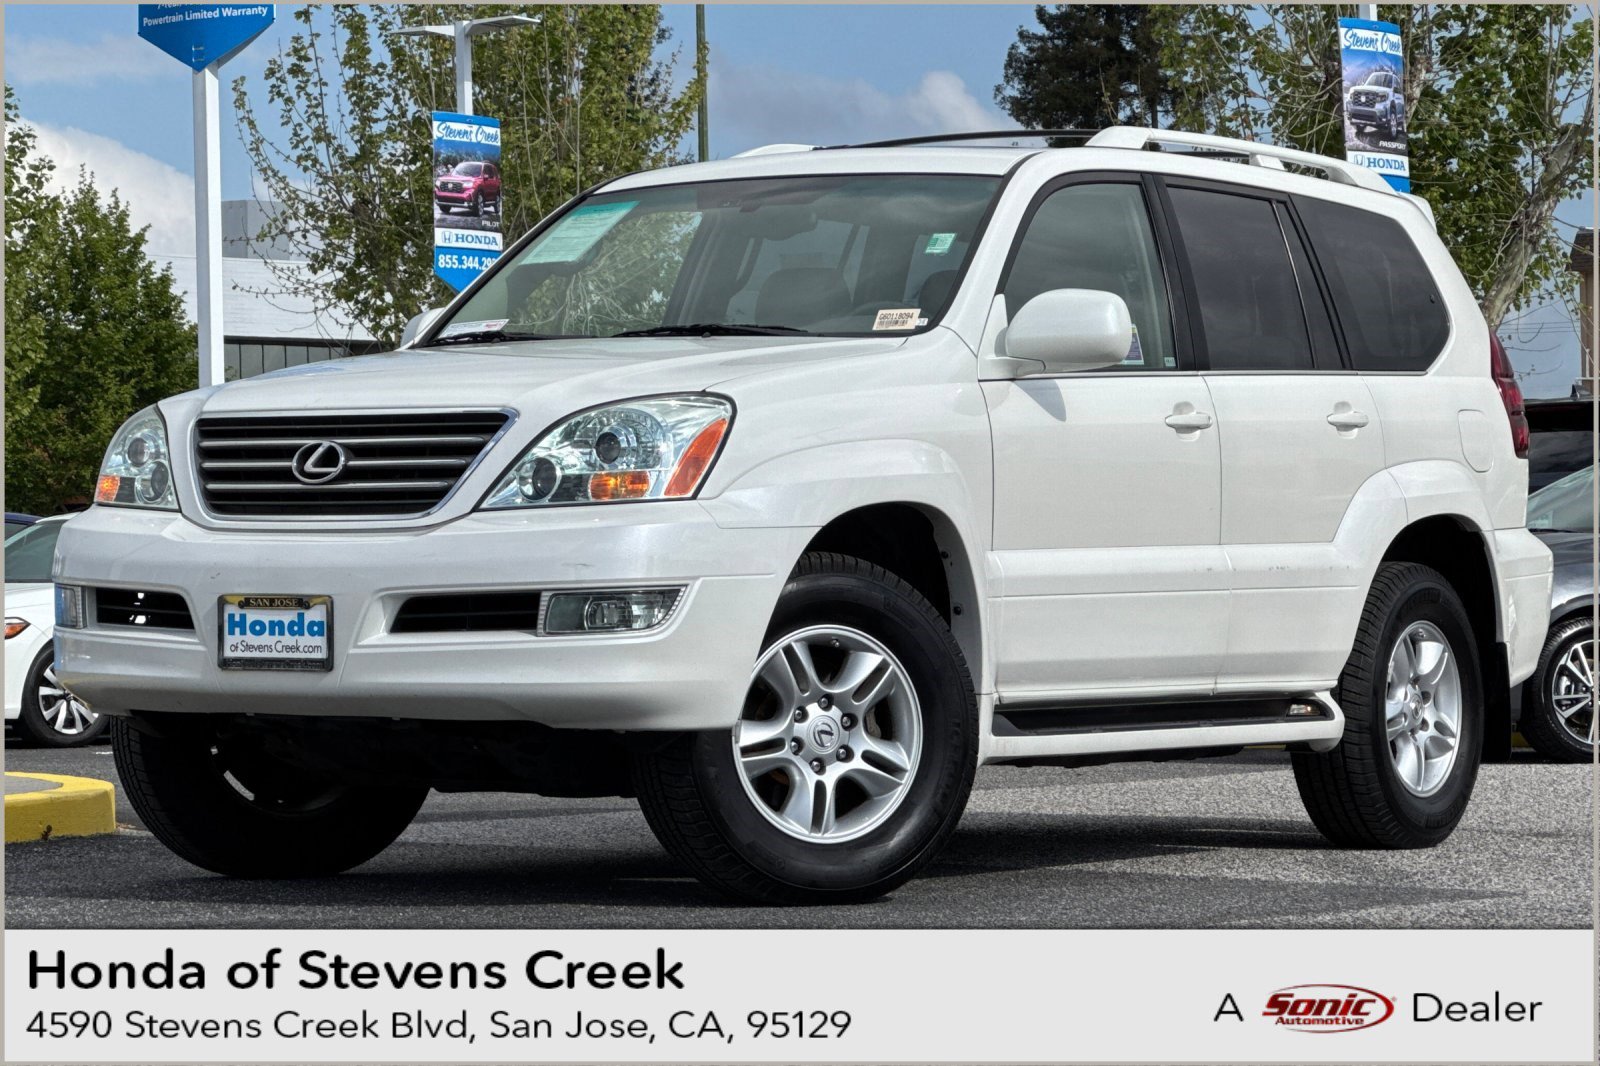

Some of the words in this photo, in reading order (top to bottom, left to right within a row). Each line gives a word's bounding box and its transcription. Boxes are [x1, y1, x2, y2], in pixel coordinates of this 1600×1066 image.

[143, 12, 183, 27] Powertrain
[185, 8, 219, 20] Limited
[221, 6, 268, 17] Warranty
[1344, 28, 1379, 51] Stevens
[1381, 32, 1401, 53] Creek
[436, 121, 473, 142] Stevens
[475, 125, 499, 144] Creek
[1379, 140, 1406, 150] PASSPORT
[1366, 157, 1406, 171] HONDA
[454, 233, 498, 246] HONDA
[249, 599, 270, 607] SAN
[272, 599, 298, 607] JOSE
[227, 612, 325, 637] Honda
[230, 641, 239, 653] of
[240, 640, 273, 653] Stevens
[274, 639, 322, 654] Creek.com
